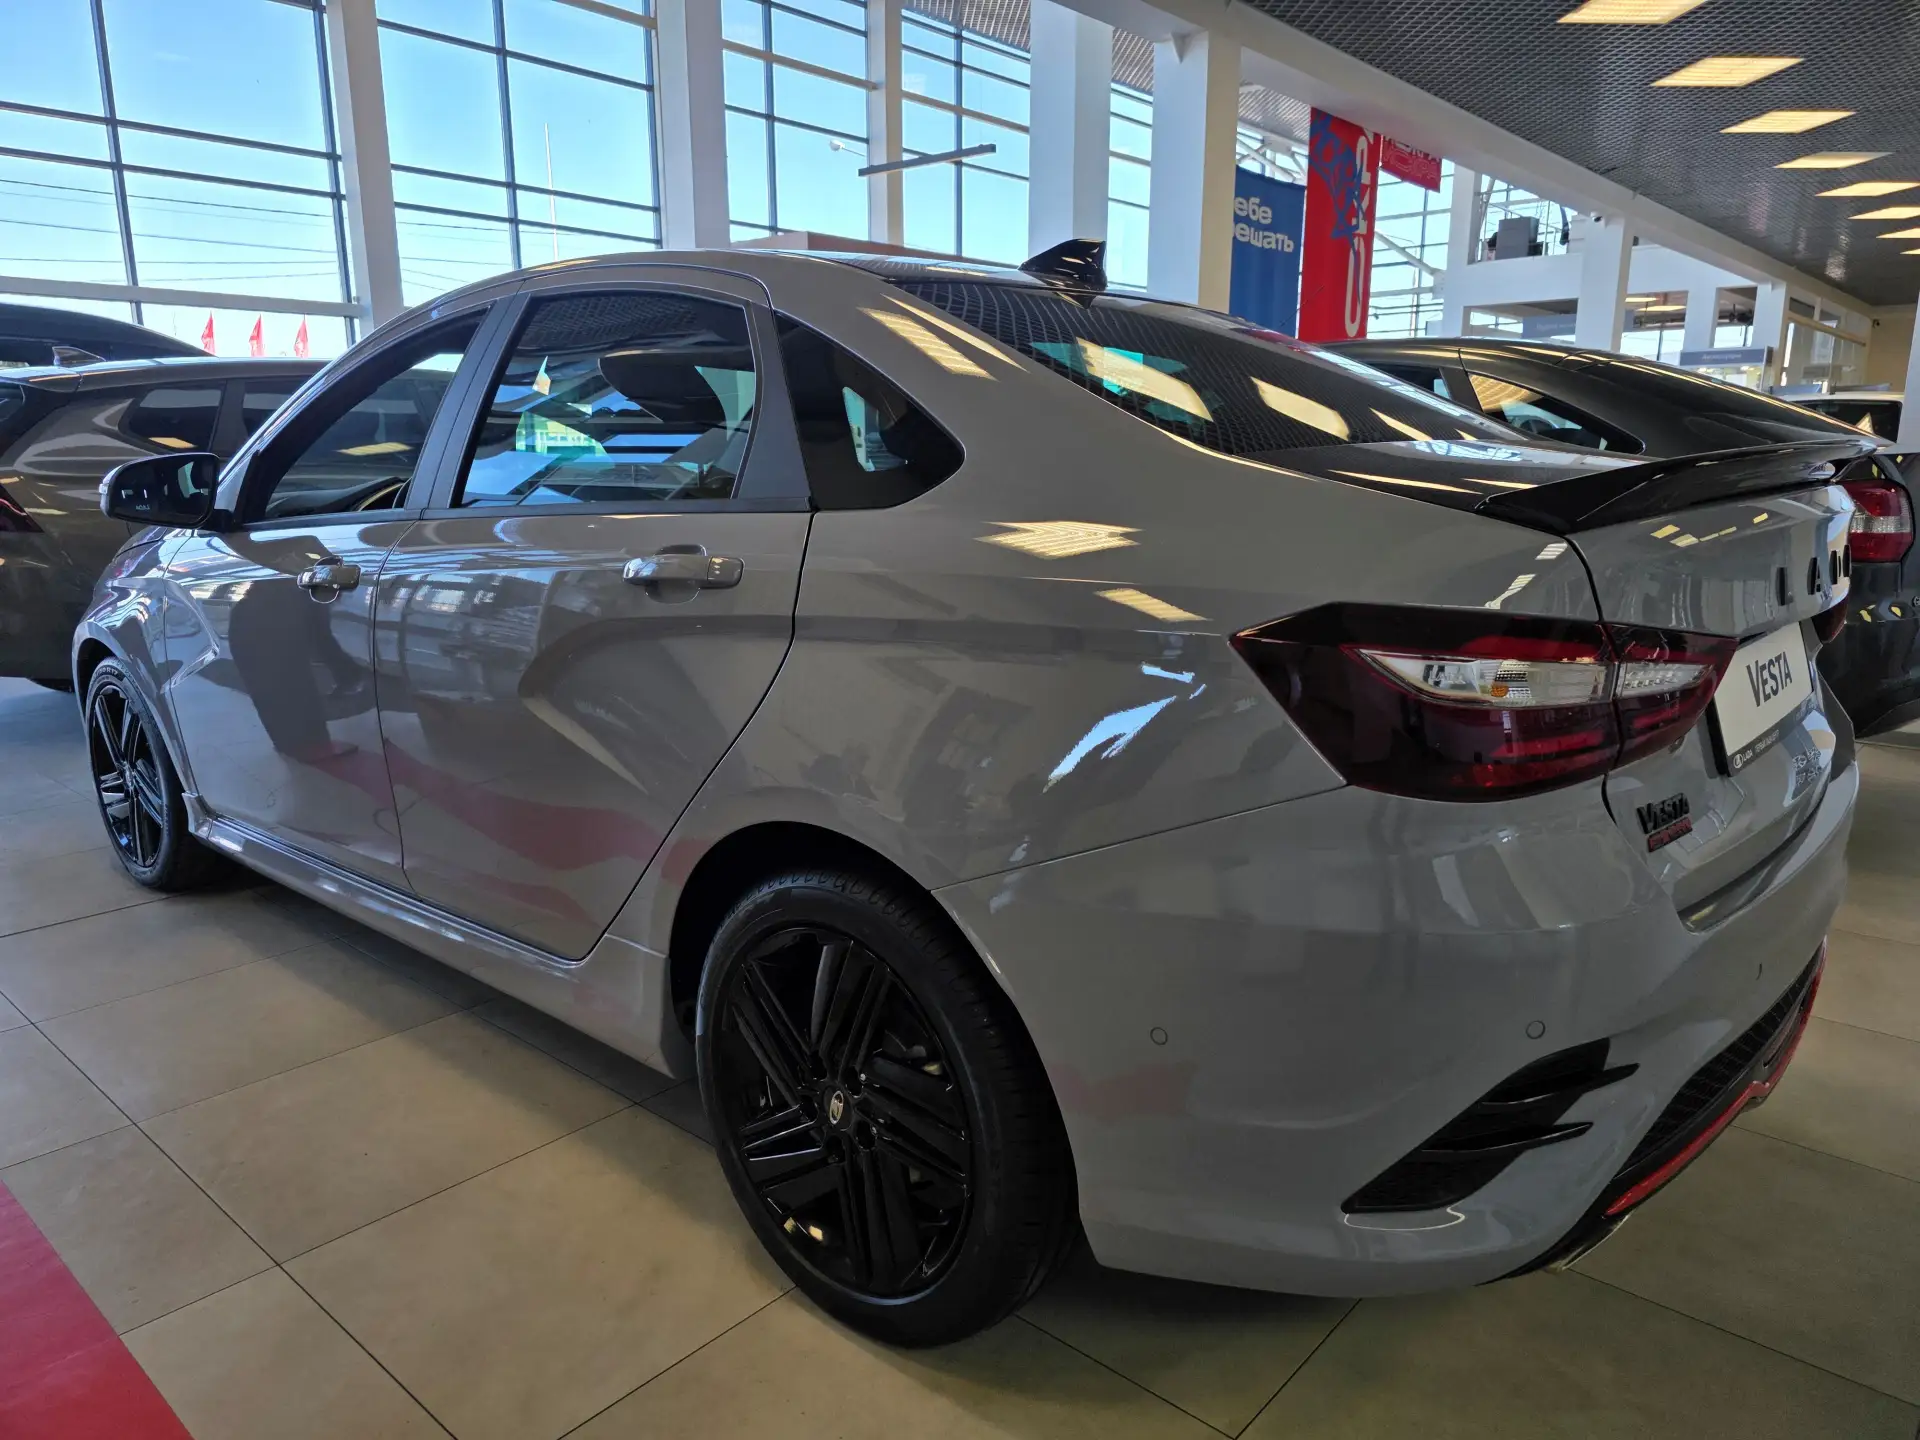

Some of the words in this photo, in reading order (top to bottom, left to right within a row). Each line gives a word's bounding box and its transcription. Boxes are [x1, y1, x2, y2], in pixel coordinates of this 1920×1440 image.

[1234, 196, 1272, 225] ебе
[1233, 222, 1295, 253] ешать
[1745, 651, 1793, 708] VESTA
[1636, 793, 1690, 834] VESTA
